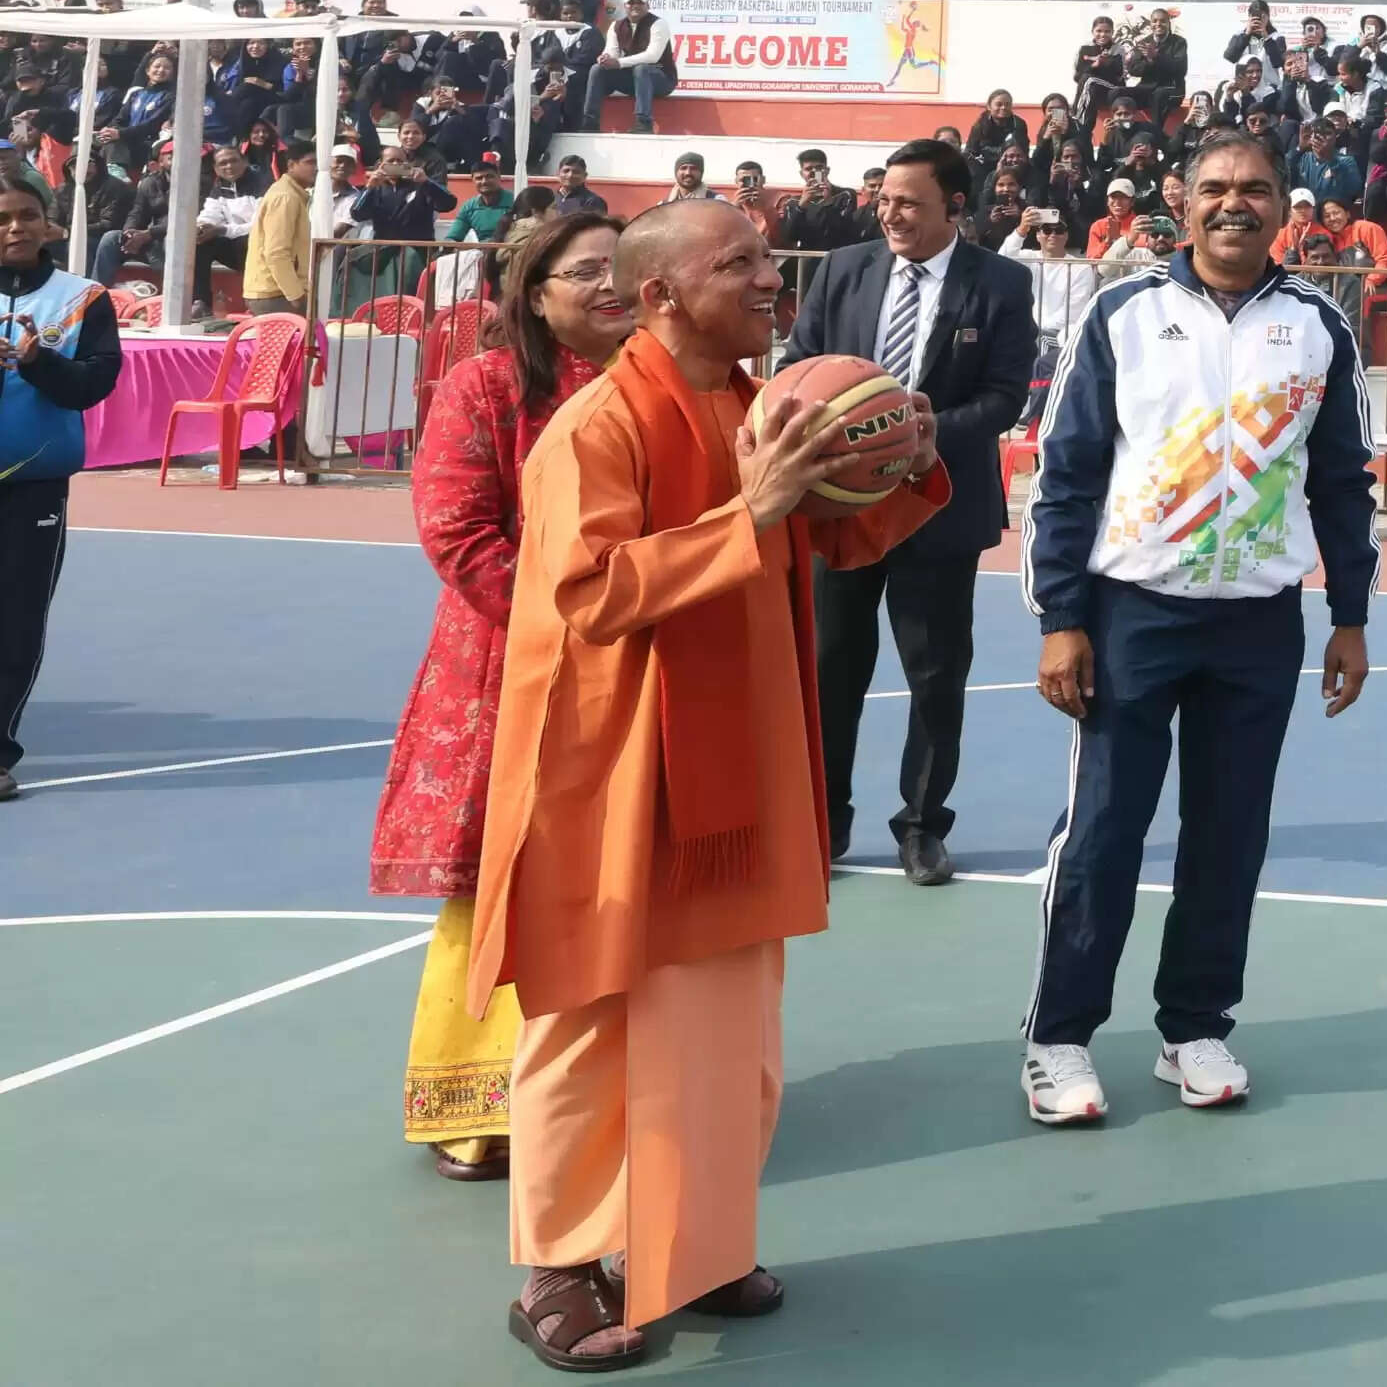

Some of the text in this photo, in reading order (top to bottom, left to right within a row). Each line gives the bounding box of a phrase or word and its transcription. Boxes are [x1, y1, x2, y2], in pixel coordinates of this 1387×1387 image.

[738, 0, 783, 12] BASKETBALL
[785, 0, 820, 14] (WOMEN)
[822, 1, 872, 13] TOURNAMENT
[1158, 332, 1190, 342] adidas
[1267, 339, 1293, 347] INDIA
